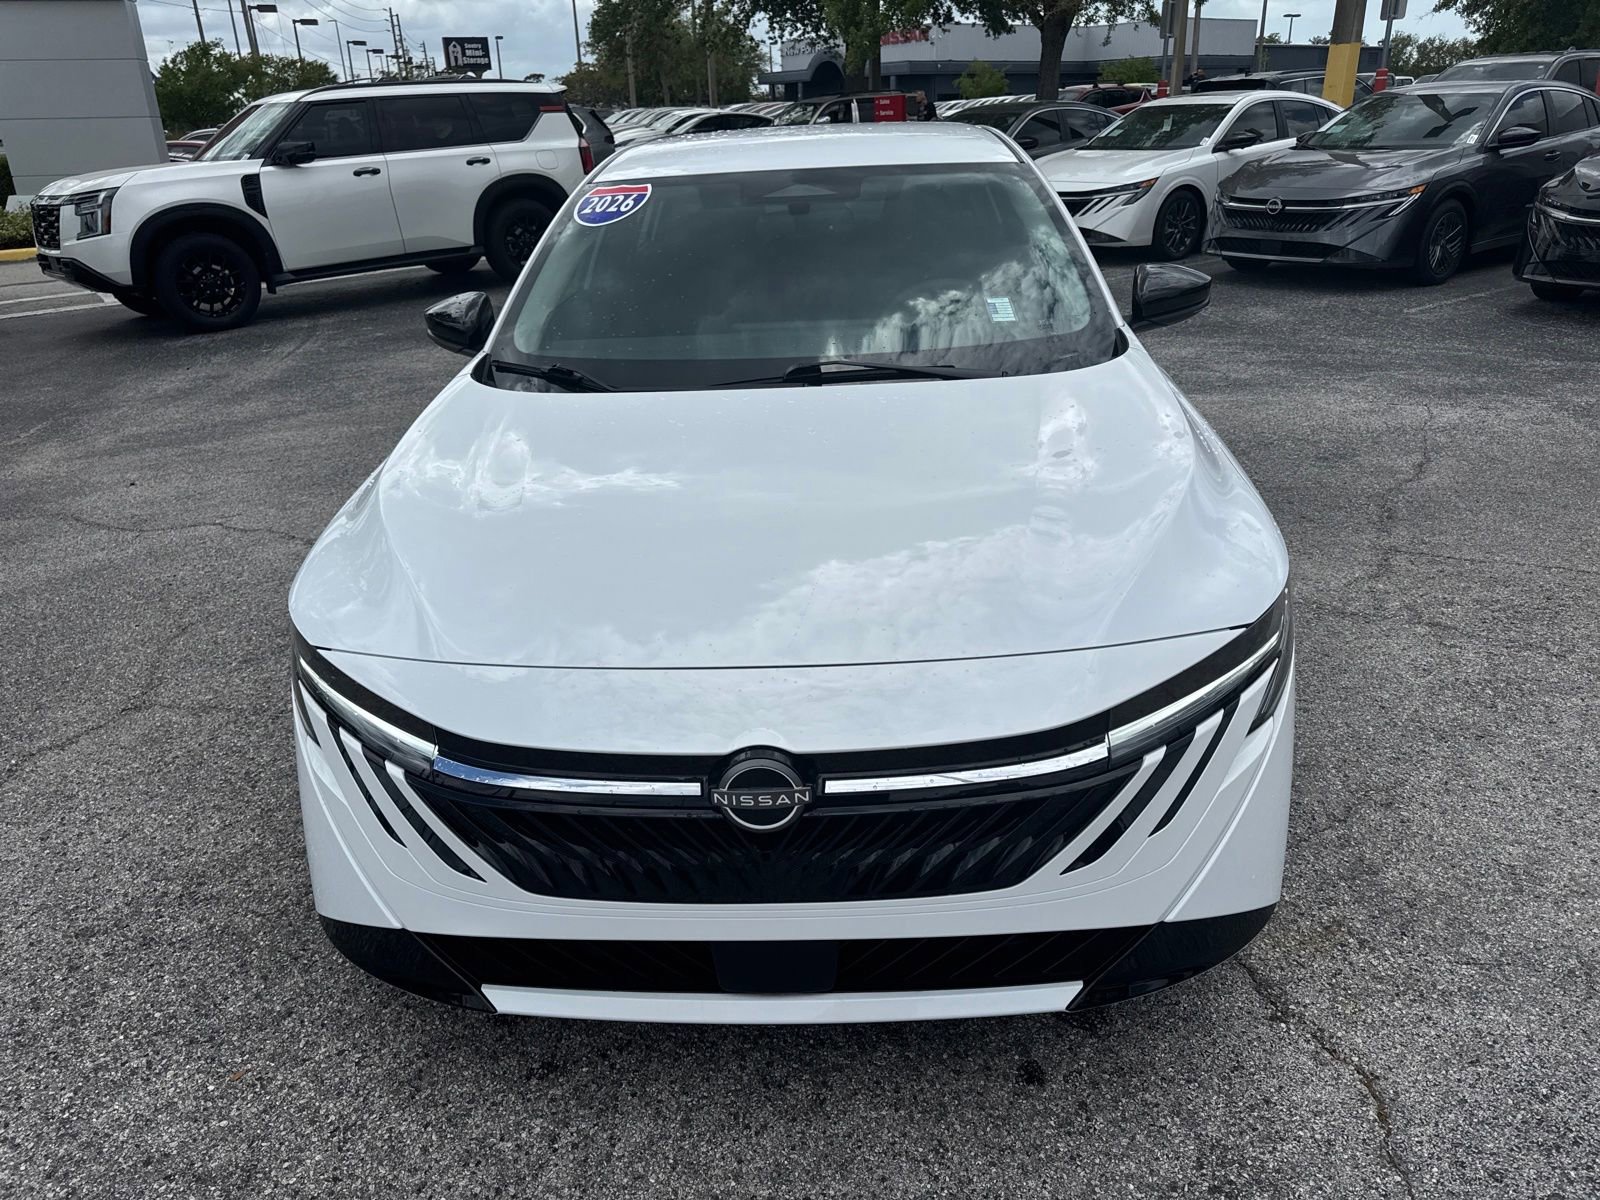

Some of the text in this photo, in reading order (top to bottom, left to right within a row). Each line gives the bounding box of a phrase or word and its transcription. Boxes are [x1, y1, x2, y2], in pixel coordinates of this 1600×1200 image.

[462, 56, 489, 65] Storage
[580, 194, 639, 214] 2026
[713, 791, 810, 807] NISSAN
